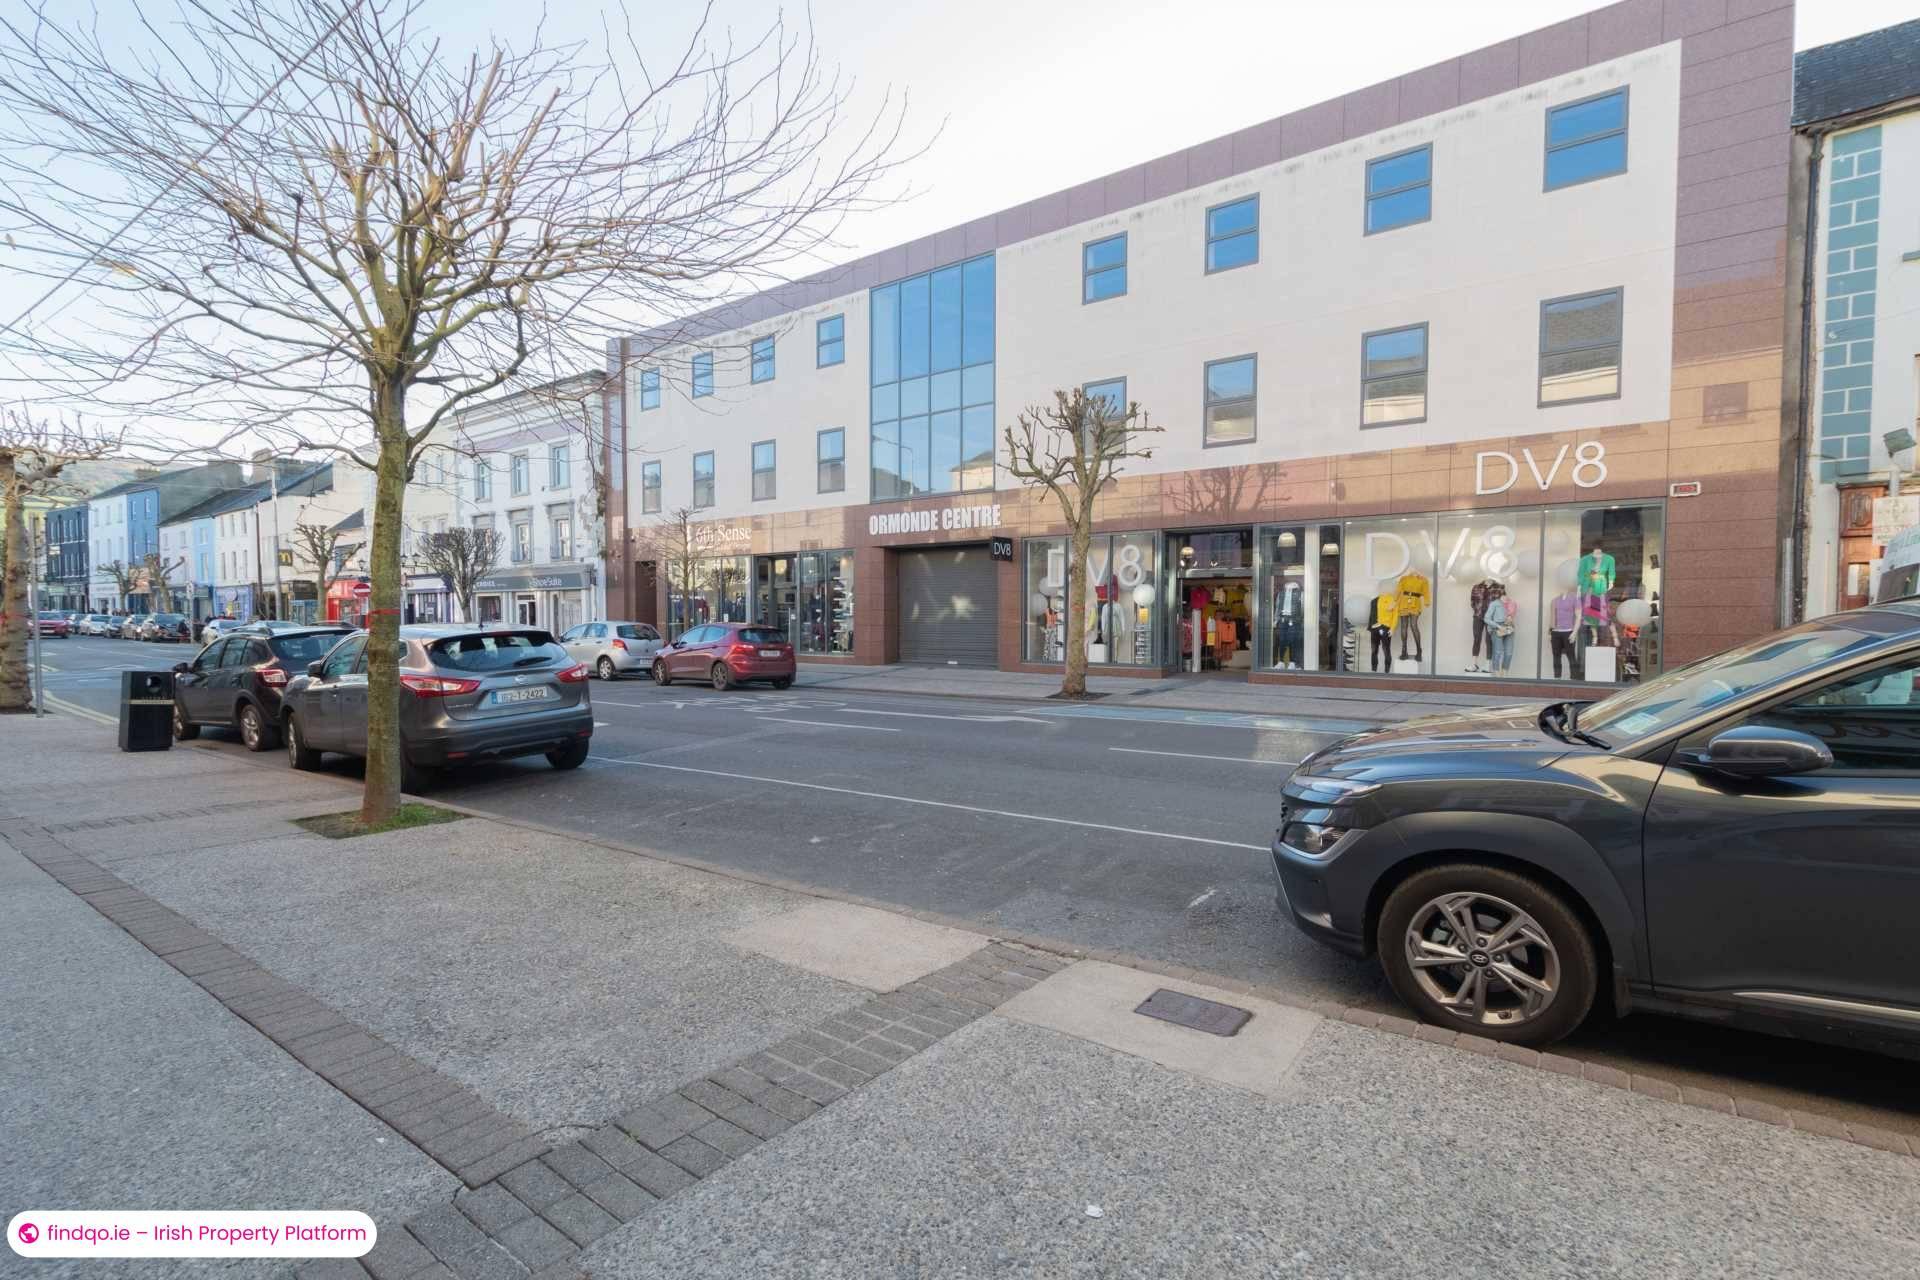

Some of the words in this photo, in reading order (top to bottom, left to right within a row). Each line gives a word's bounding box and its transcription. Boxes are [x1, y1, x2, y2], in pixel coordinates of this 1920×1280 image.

[1475, 440, 1608, 496] DV8
[718, 525, 752, 541] Sense
[869, 510, 938, 535] ORMONDE
[942, 504, 1001, 530] CENTRE
[993, 542, 1012, 556] DV8
[1364, 525, 1518, 581] DV8
